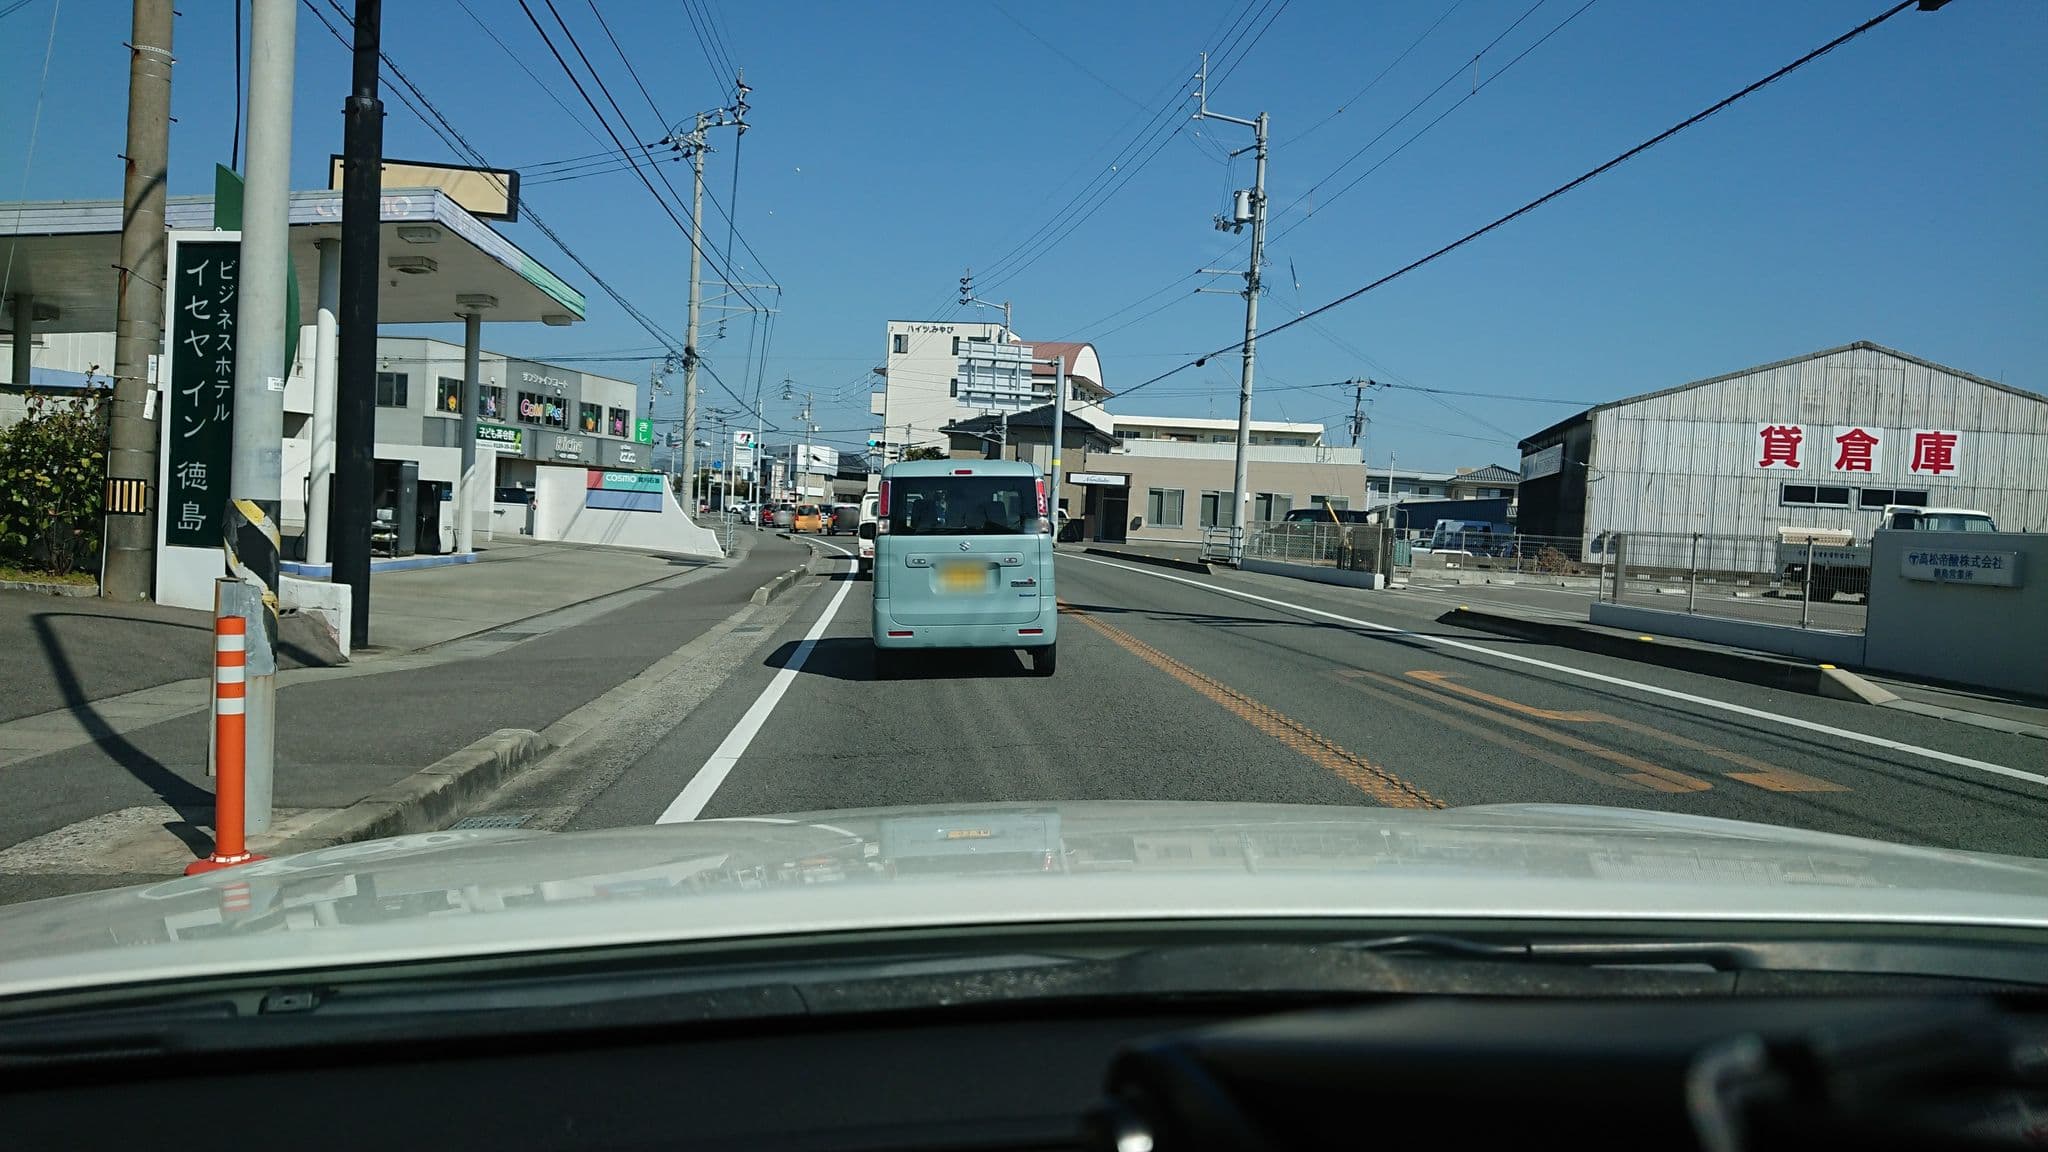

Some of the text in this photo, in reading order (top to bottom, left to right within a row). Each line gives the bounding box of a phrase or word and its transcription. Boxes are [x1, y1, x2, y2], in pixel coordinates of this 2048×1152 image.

[213, 260, 239, 422] ビジネスホテル
[907, 325, 955, 334] ハイツみやび
[1759, 424, 1958, 475] 貸倉庫
[605, 474, 637, 483] COSMO
